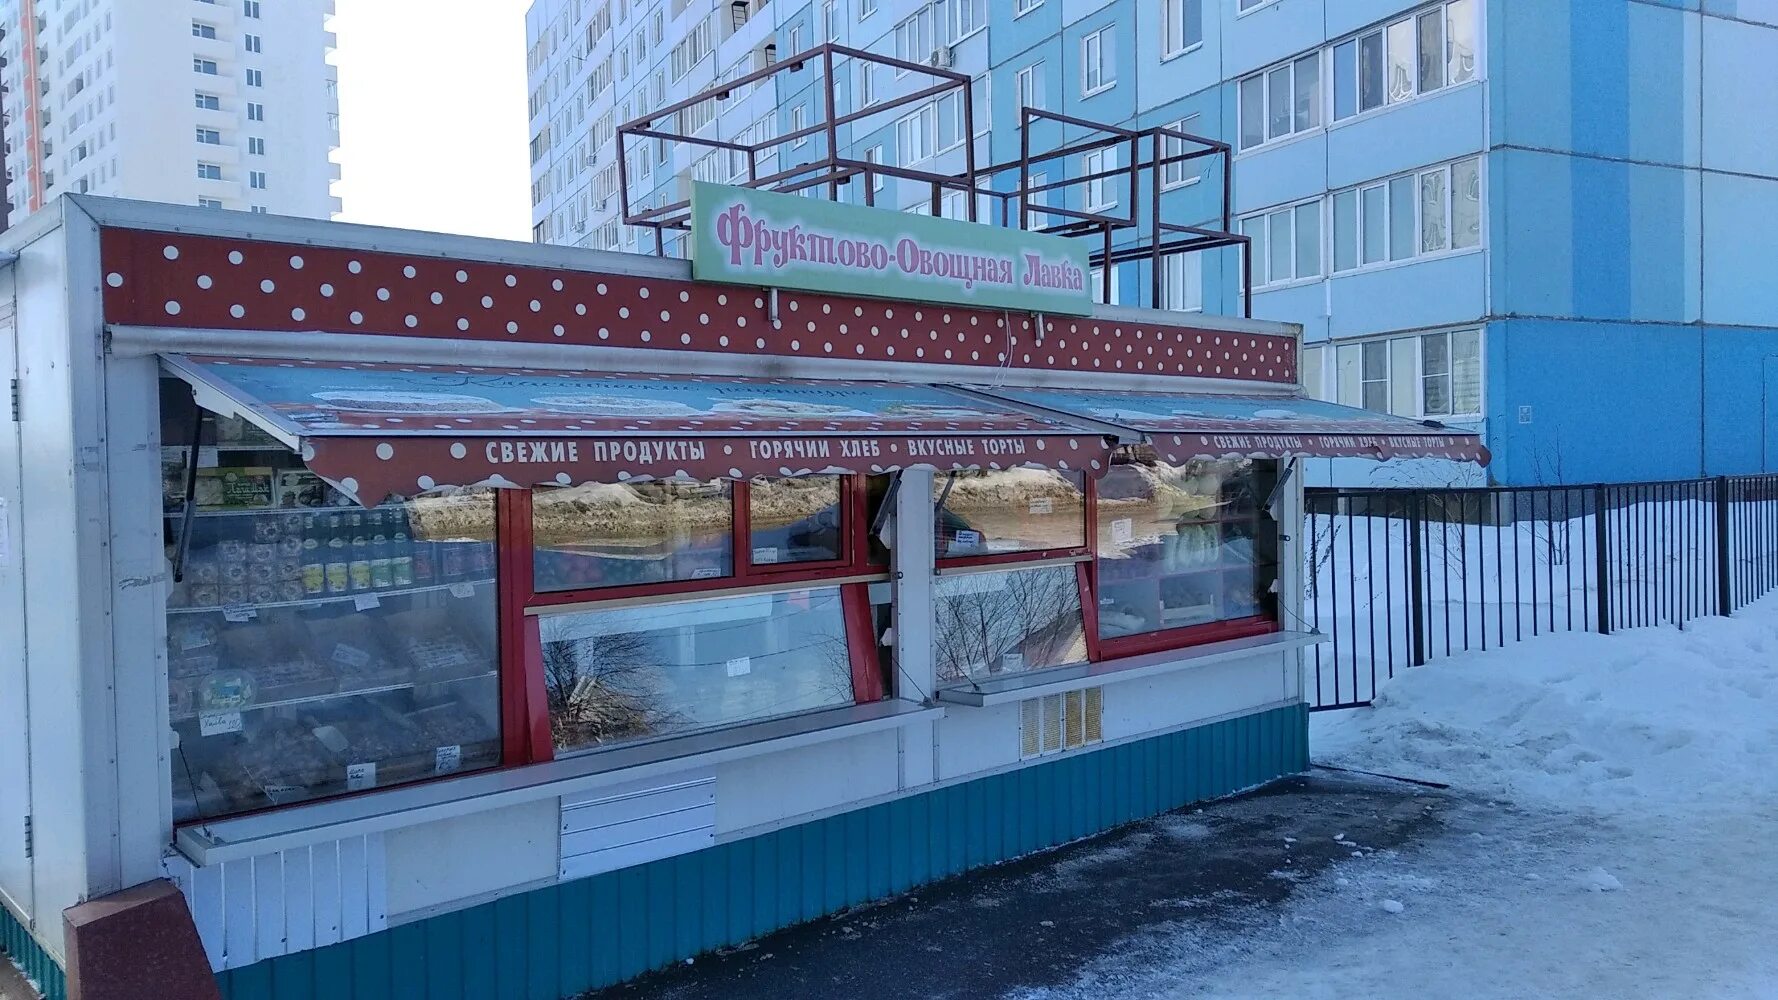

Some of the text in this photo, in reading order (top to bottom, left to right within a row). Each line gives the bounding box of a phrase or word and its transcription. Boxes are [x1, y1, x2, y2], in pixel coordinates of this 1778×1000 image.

[716, 203, 1083, 291] Фруктово-Овощная Лавка
[840, 439, 880, 458] ХЛЕБ
[907, 438, 1026, 457] ВКУСНЫЕ ТОРТЫ
[1213, 435, 1303, 450] СВЕЖИЕ ПРОДУКТЫ
[1388, 436, 1446, 448] ВКУСНЫЕ ТОРТЫ
[485, 441, 705, 464] СВЕЖИЕ ПРОДУКТЫ
